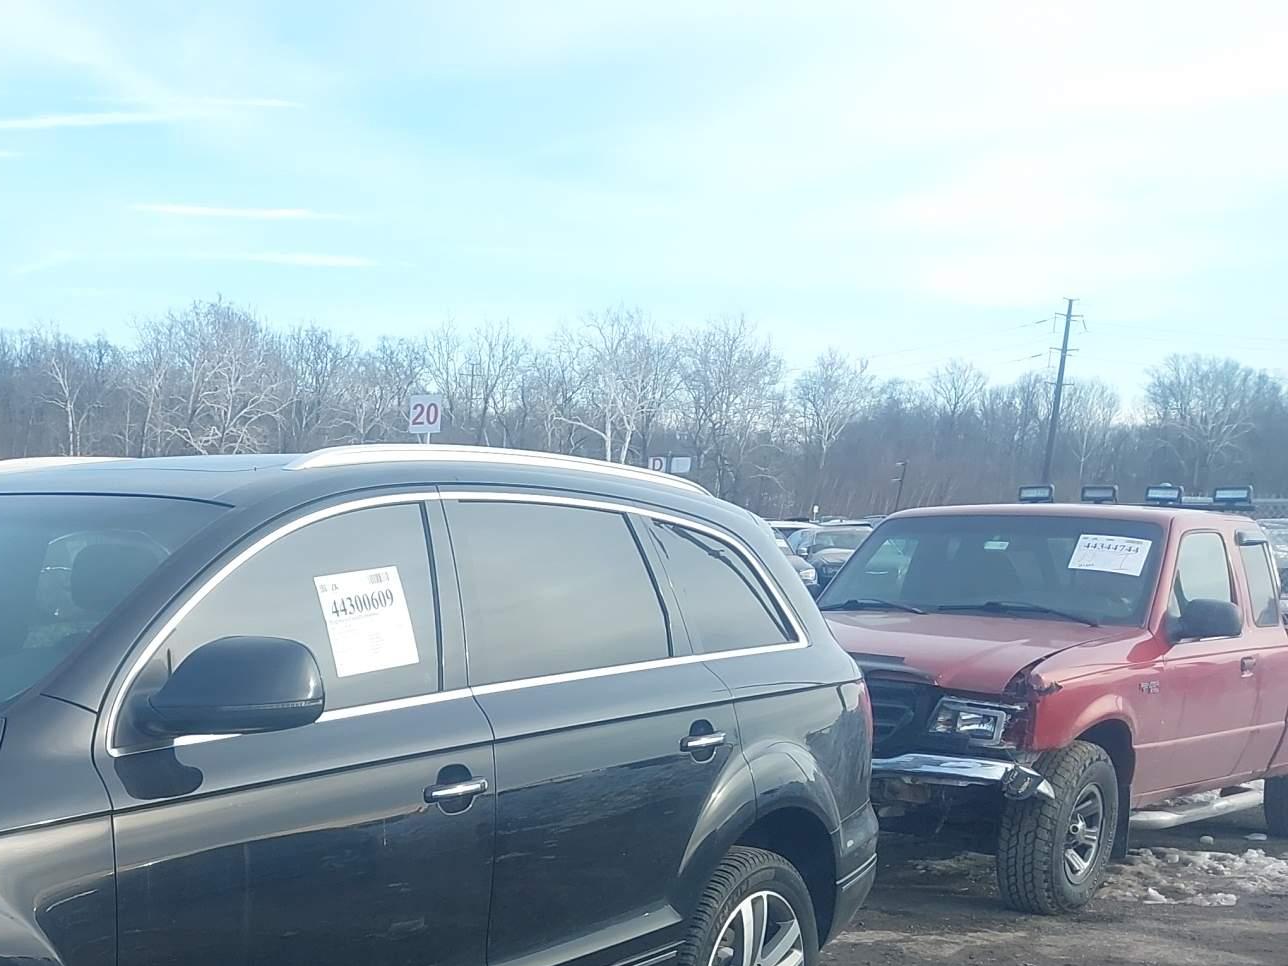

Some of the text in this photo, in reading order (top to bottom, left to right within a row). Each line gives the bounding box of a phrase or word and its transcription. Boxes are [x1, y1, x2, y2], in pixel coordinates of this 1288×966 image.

[412, 403, 439, 425] 20
[652, 457, 664, 471] D
[1083, 542, 1140, 554] 44344744
[331, 588, 394, 617] 44300609
